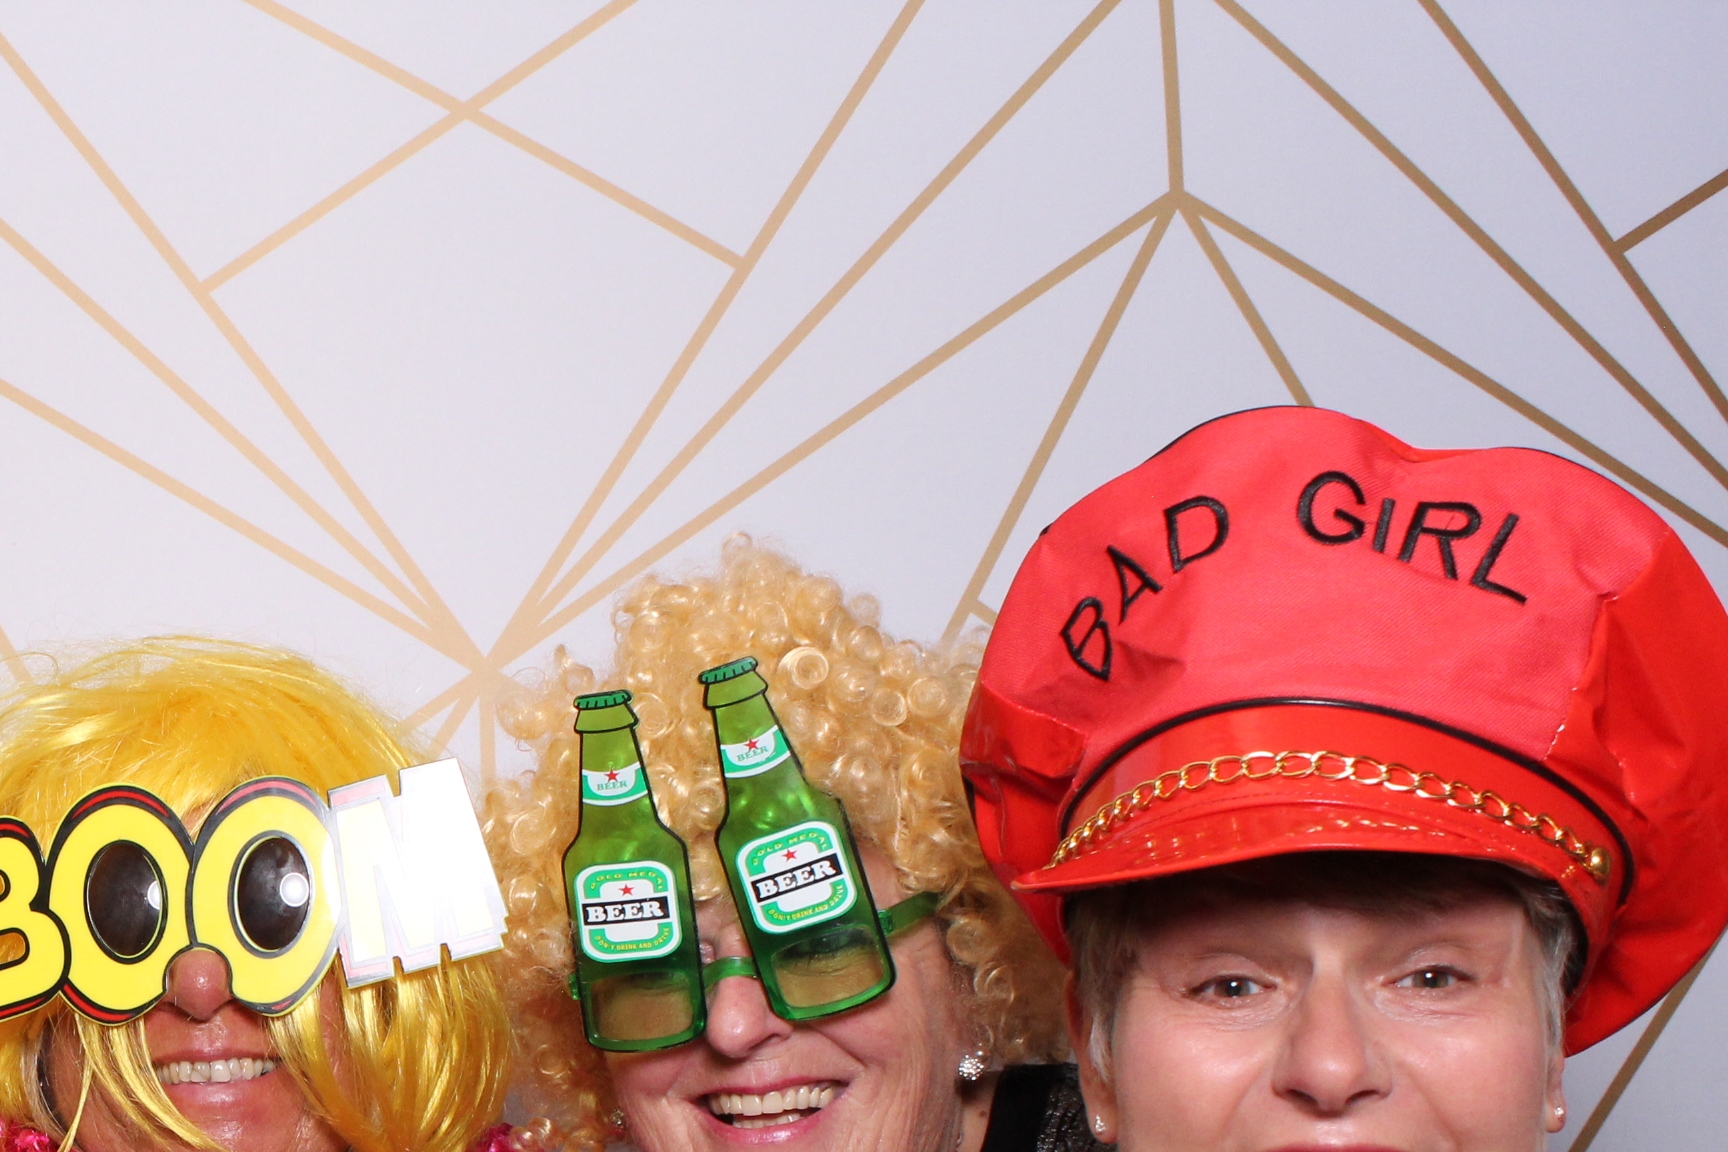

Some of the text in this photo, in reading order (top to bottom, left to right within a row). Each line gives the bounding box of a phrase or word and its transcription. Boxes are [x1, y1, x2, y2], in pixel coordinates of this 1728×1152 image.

[1060, 470, 1527, 682] BAD GIRL
[737, 746, 769, 762] BEER
[597, 780, 628, 791] BEER
[752, 832, 828, 866] GOLD MEDAL
[590, 871, 663, 891] GOLD MEDAL
[755, 860, 837, 899] BEER
[585, 900, 664, 923] BEER
